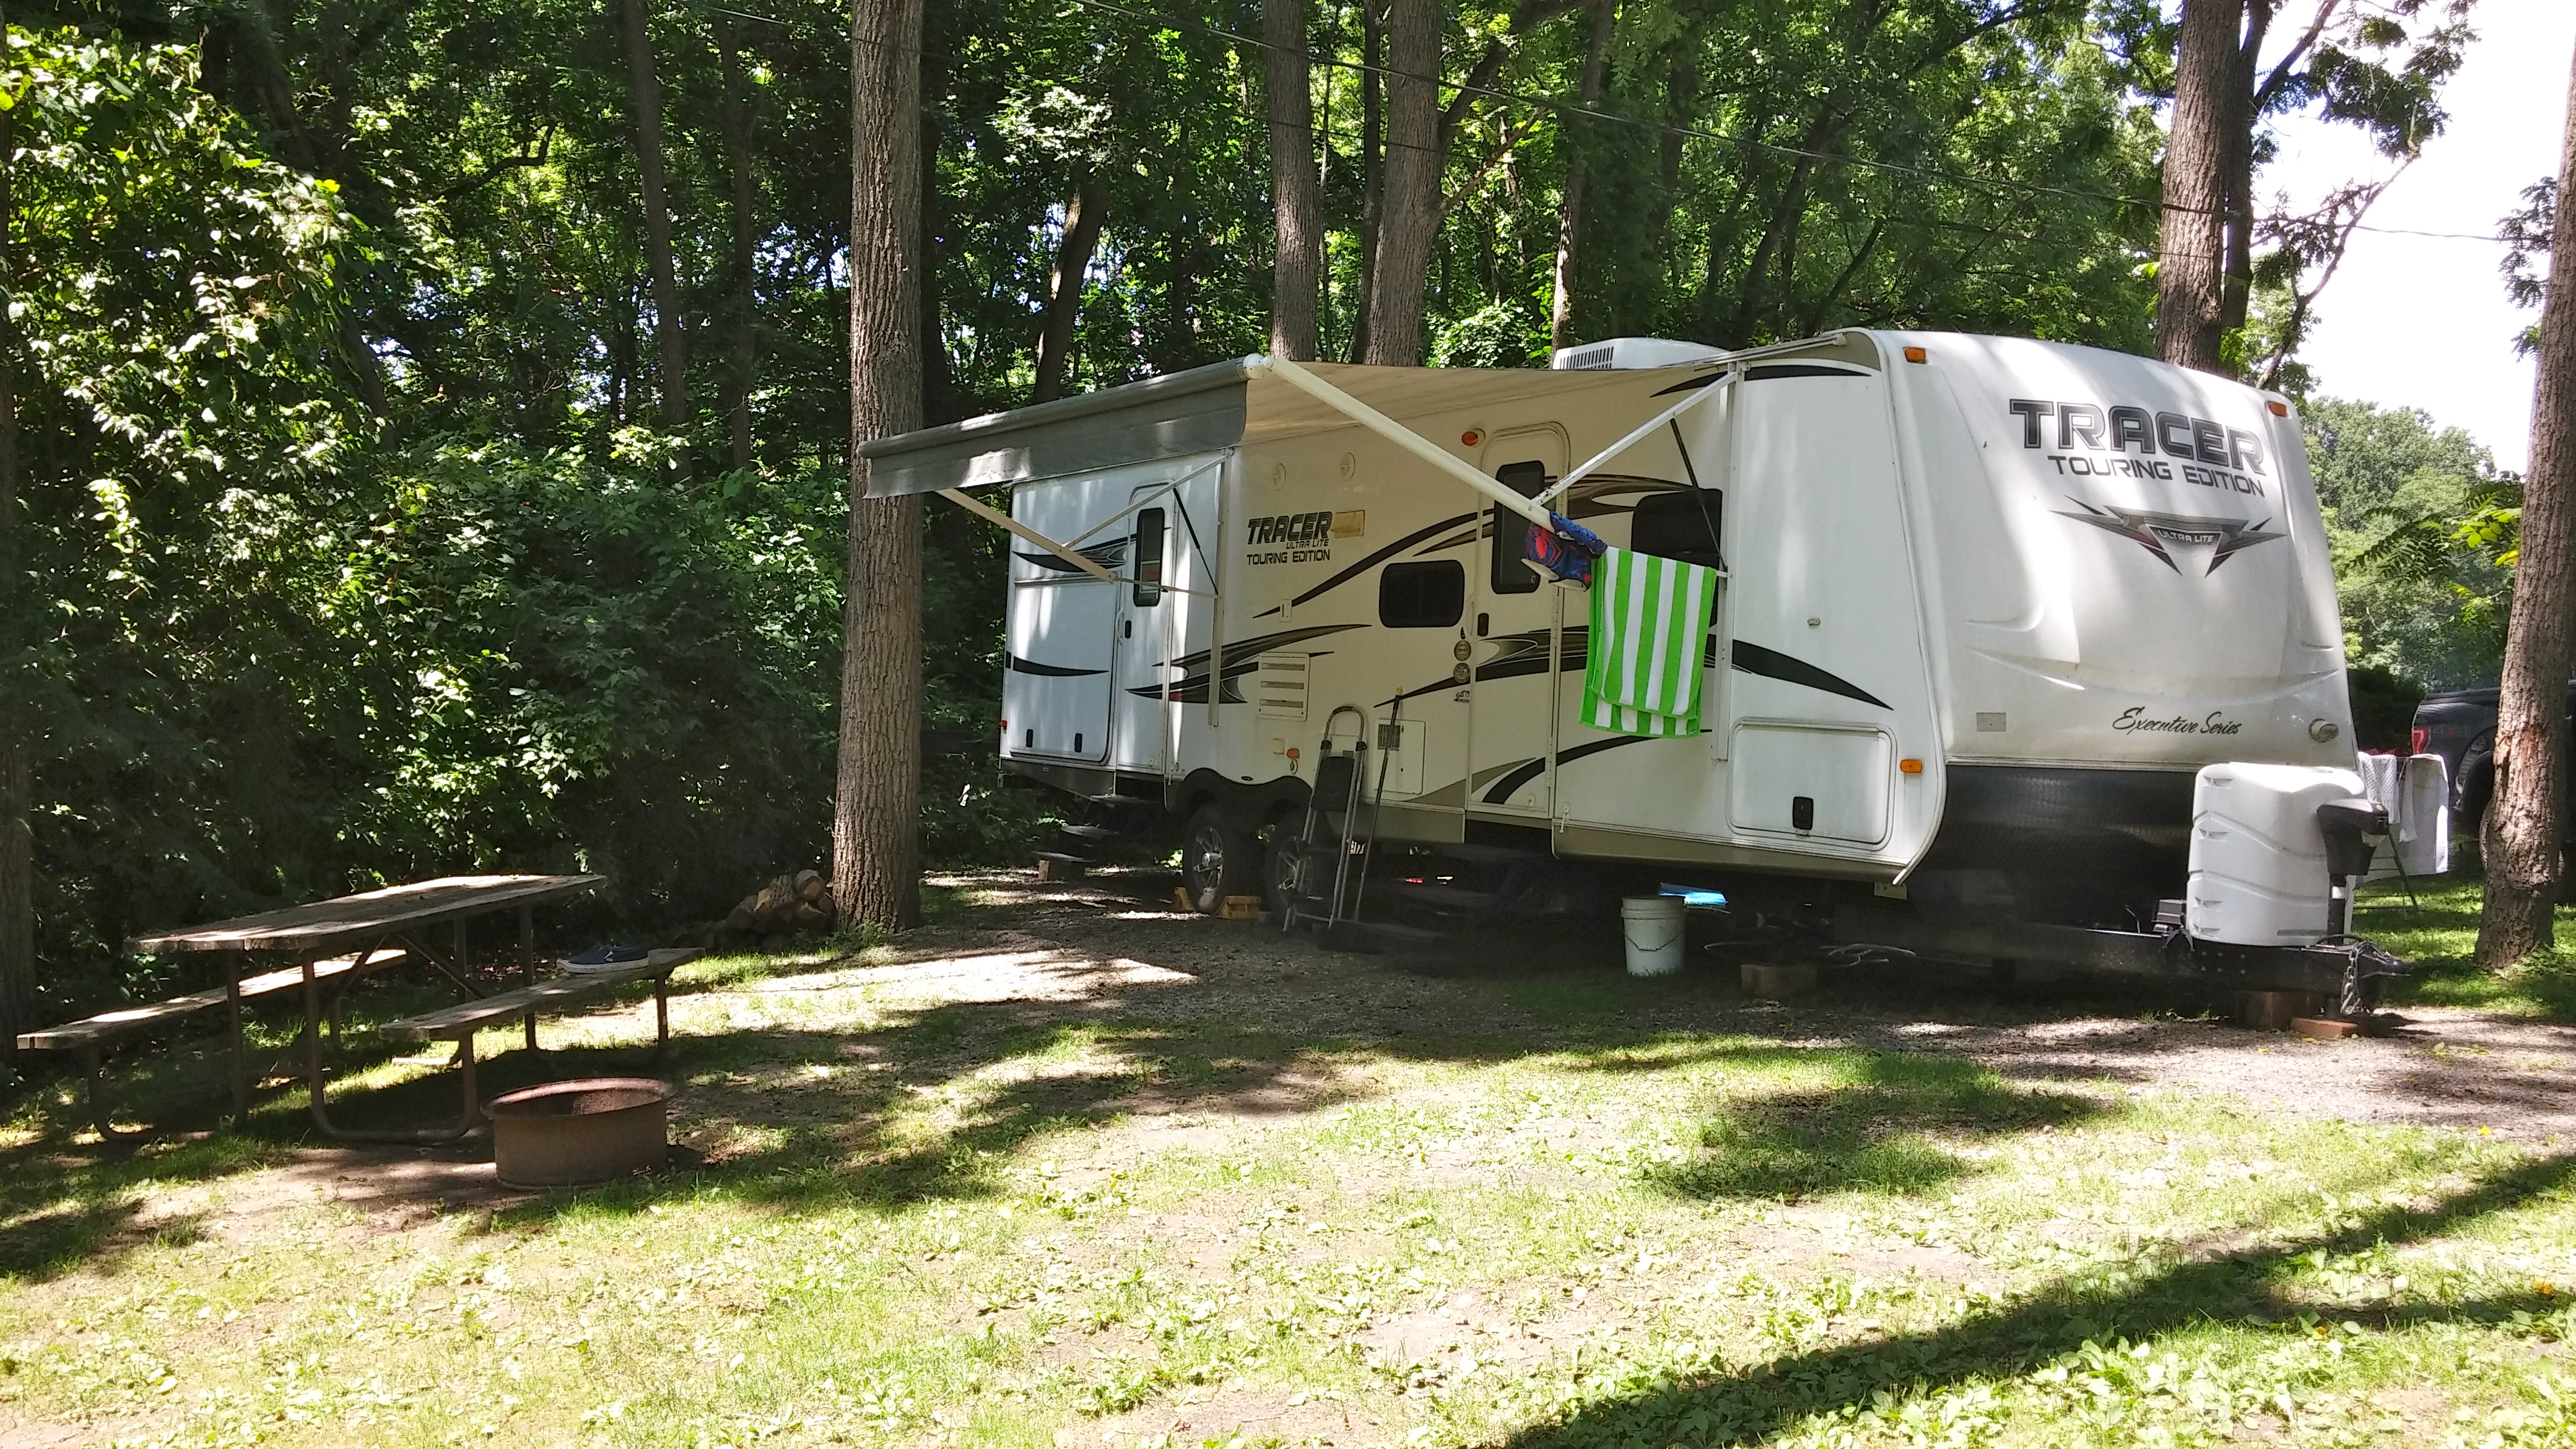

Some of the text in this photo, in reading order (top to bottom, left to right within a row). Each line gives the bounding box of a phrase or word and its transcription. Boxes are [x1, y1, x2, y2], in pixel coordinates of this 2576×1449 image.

[2009, 399, 2266, 476] TRACER
[2048, 456, 2265, 497] TOURING EDITION
[1247, 511, 1333, 545] TRACER
[2157, 529, 2214, 543] ULTRA LITE
[1247, 550, 1330, 565] TOURING EDITION
[1286, 539, 1329, 549] ULTRA LITE
[2112, 706, 2242, 736] Executive Series
